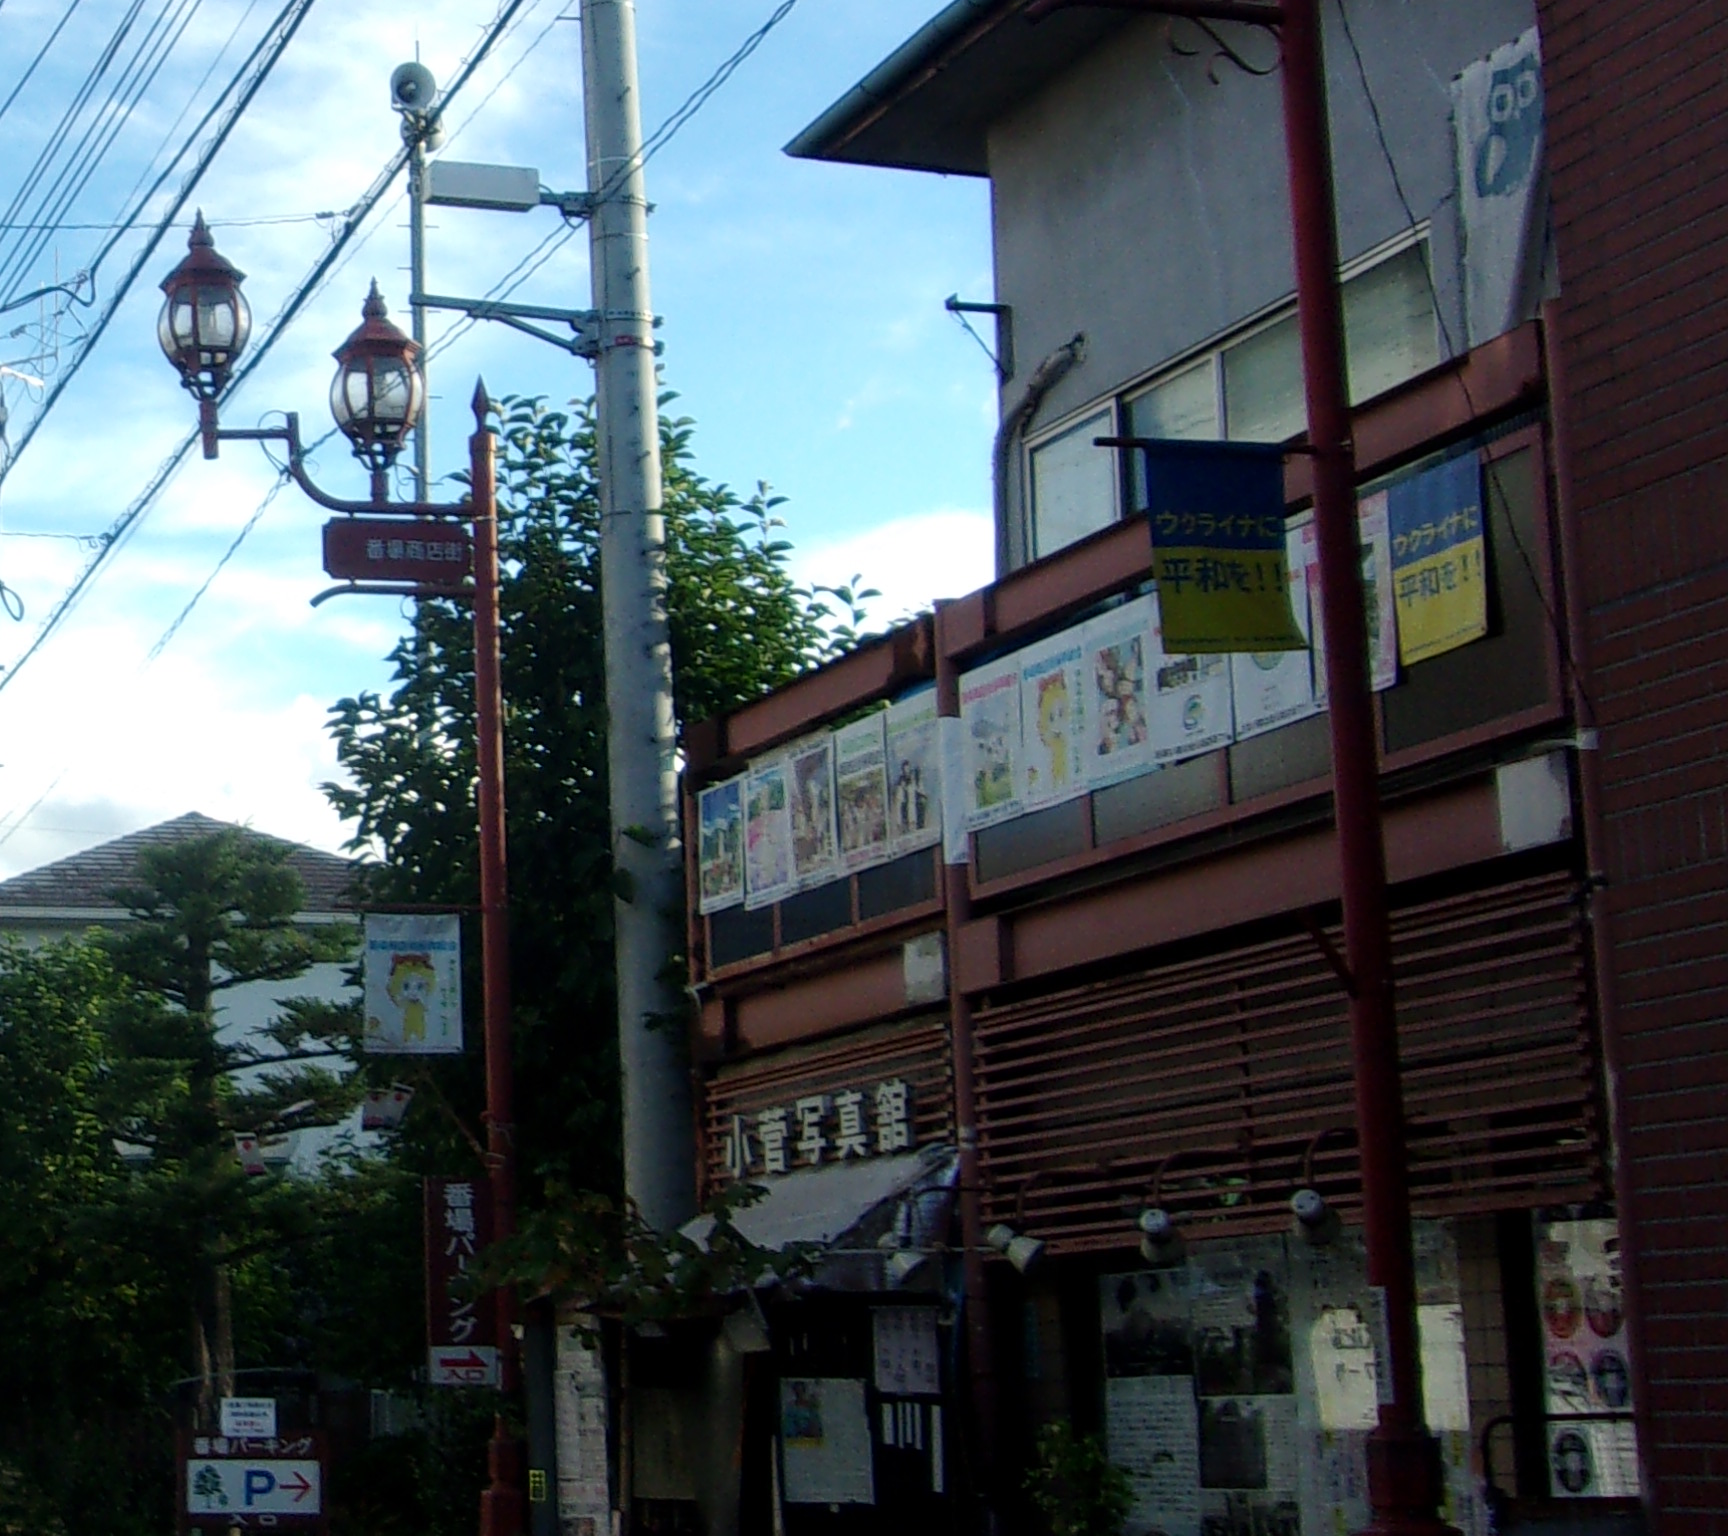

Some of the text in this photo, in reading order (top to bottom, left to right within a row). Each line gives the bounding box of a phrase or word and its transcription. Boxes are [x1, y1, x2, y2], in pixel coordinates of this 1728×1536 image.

[1155, 512, 1280, 539] ウクライナに
[1393, 505, 1479, 557] ウクライナに
[725, 1077, 910, 1180] 小菅写真館
[443, 1182, 478, 1344] 番場パーング
[244, 1469, 277, 1506] P
